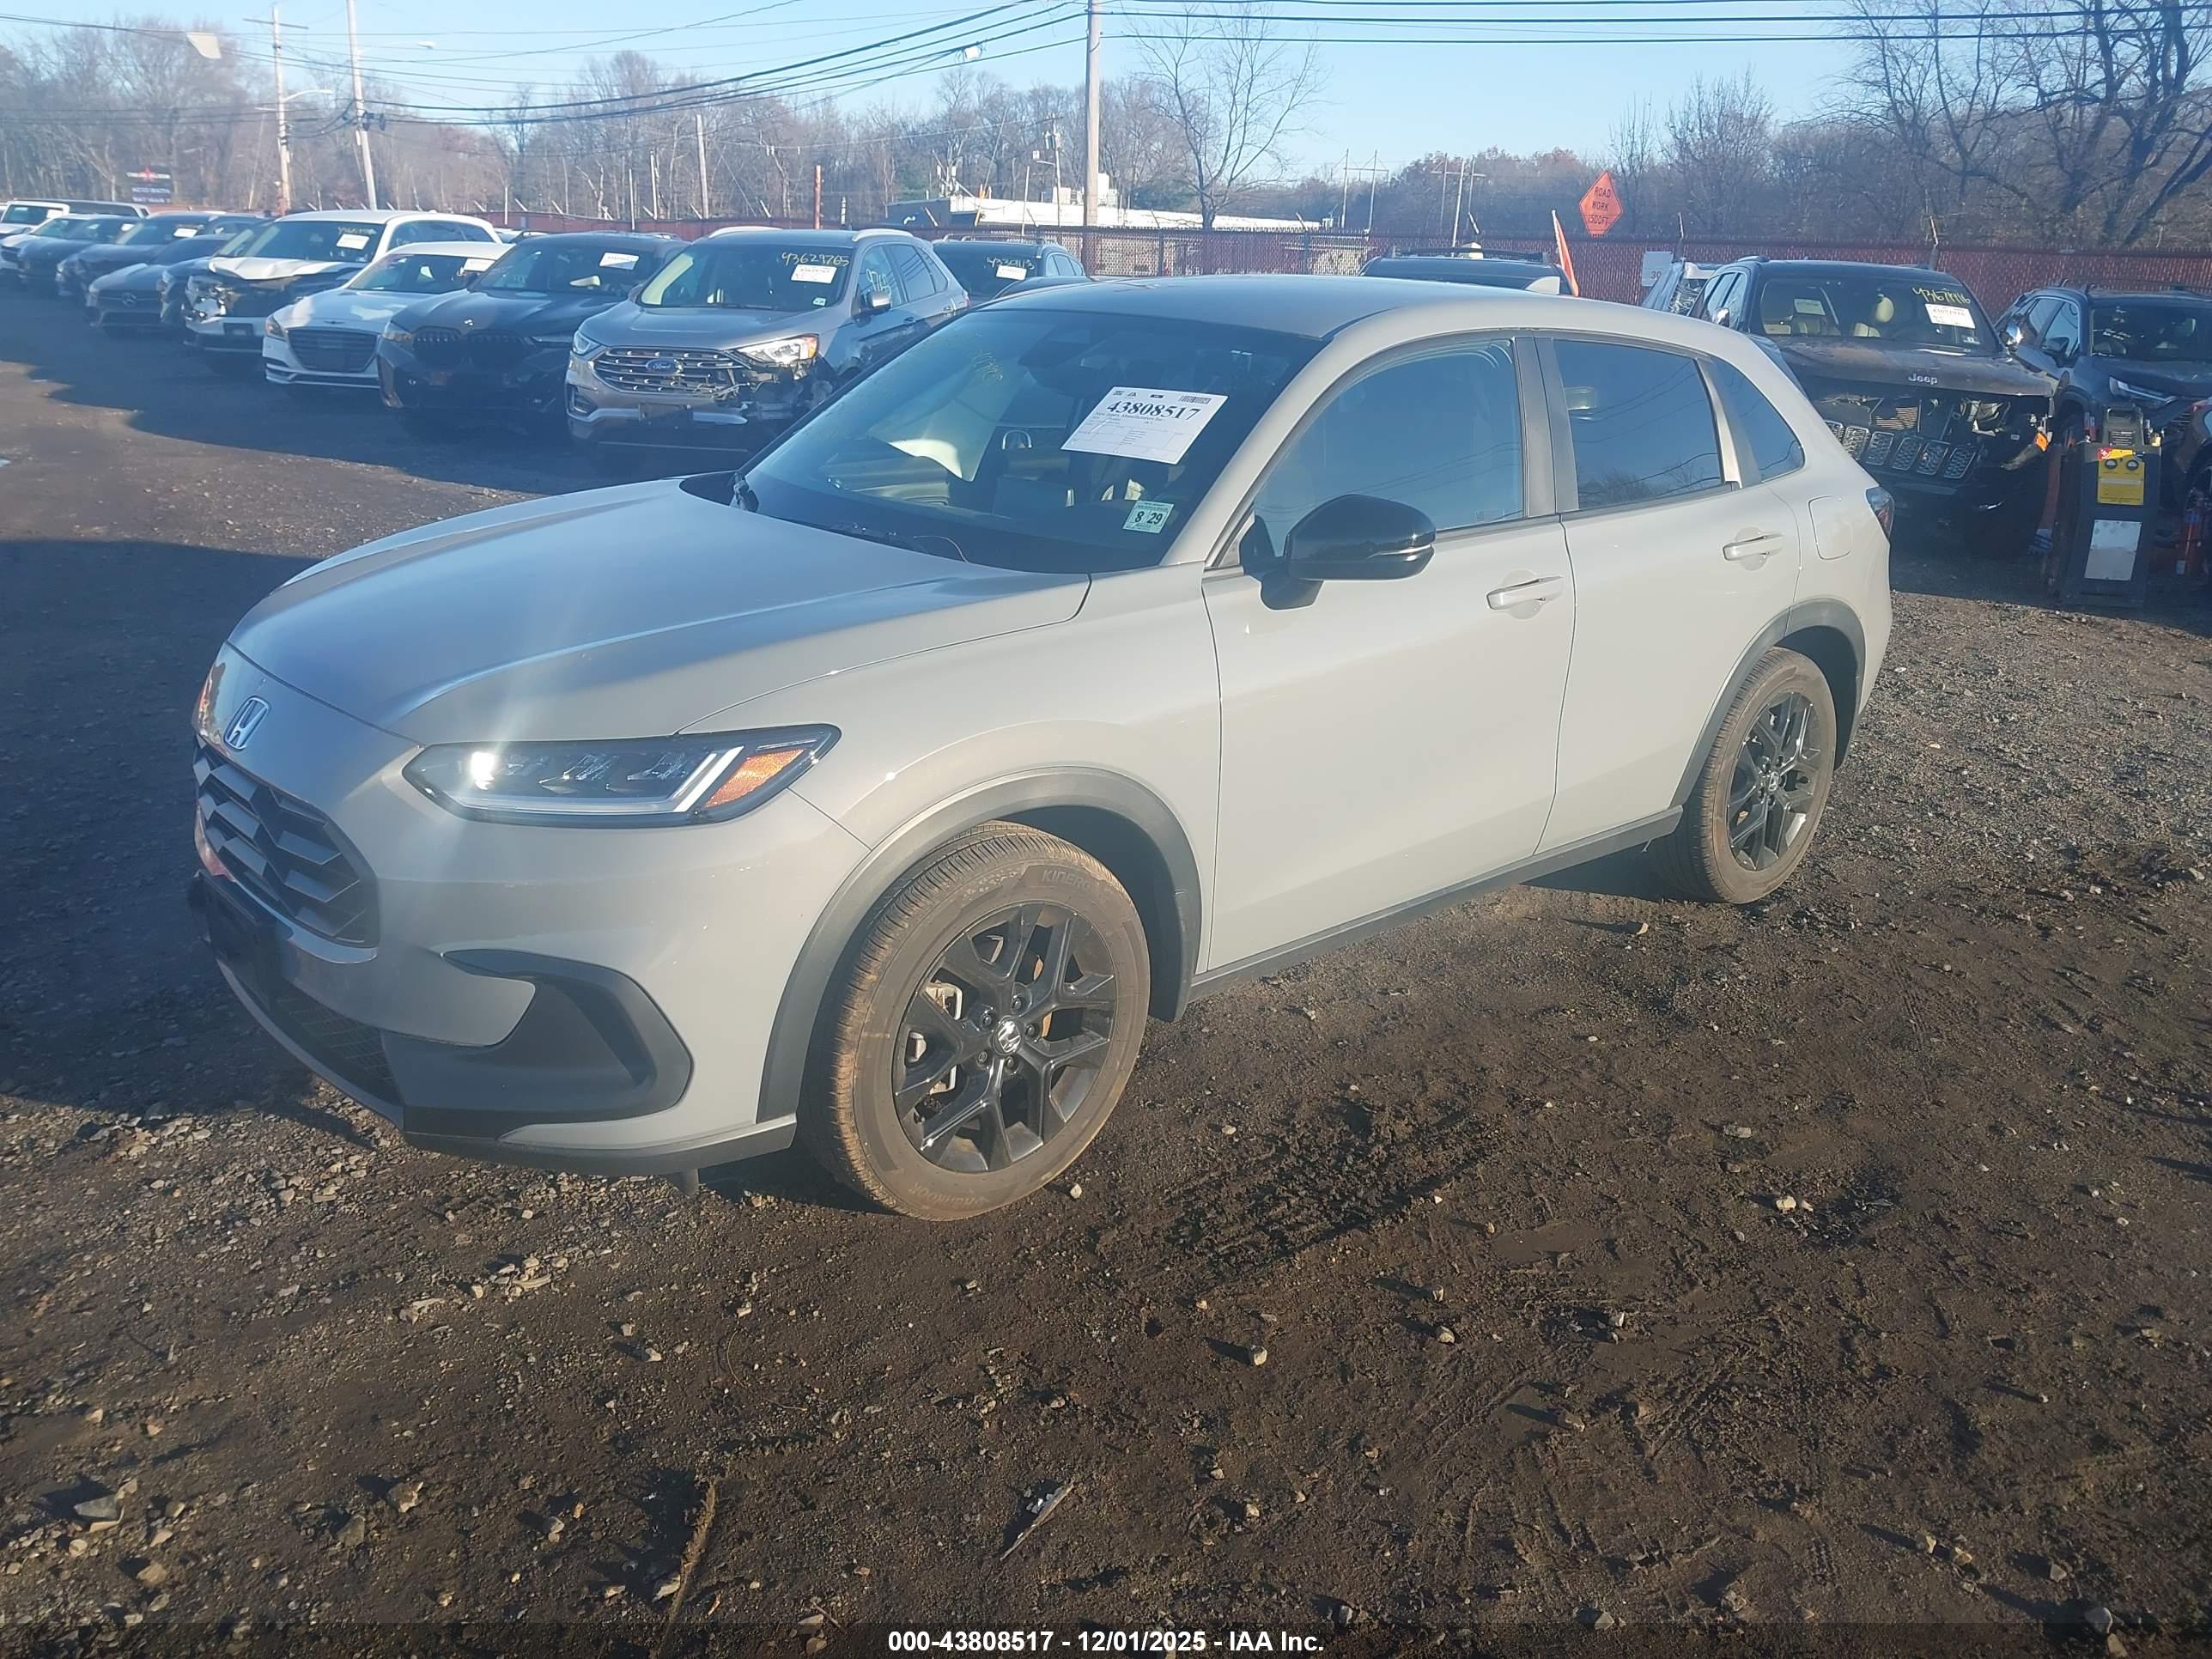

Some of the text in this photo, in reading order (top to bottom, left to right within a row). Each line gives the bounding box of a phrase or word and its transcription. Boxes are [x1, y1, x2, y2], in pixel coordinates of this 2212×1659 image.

[1594, 186, 1611, 198] ROAD
[1592, 201, 1609, 211] WORK
[1908, 373, 1938, 386] Jeep
[1107, 400, 1201, 421] 43808517
[1134, 511, 1163, 525] 8 29
